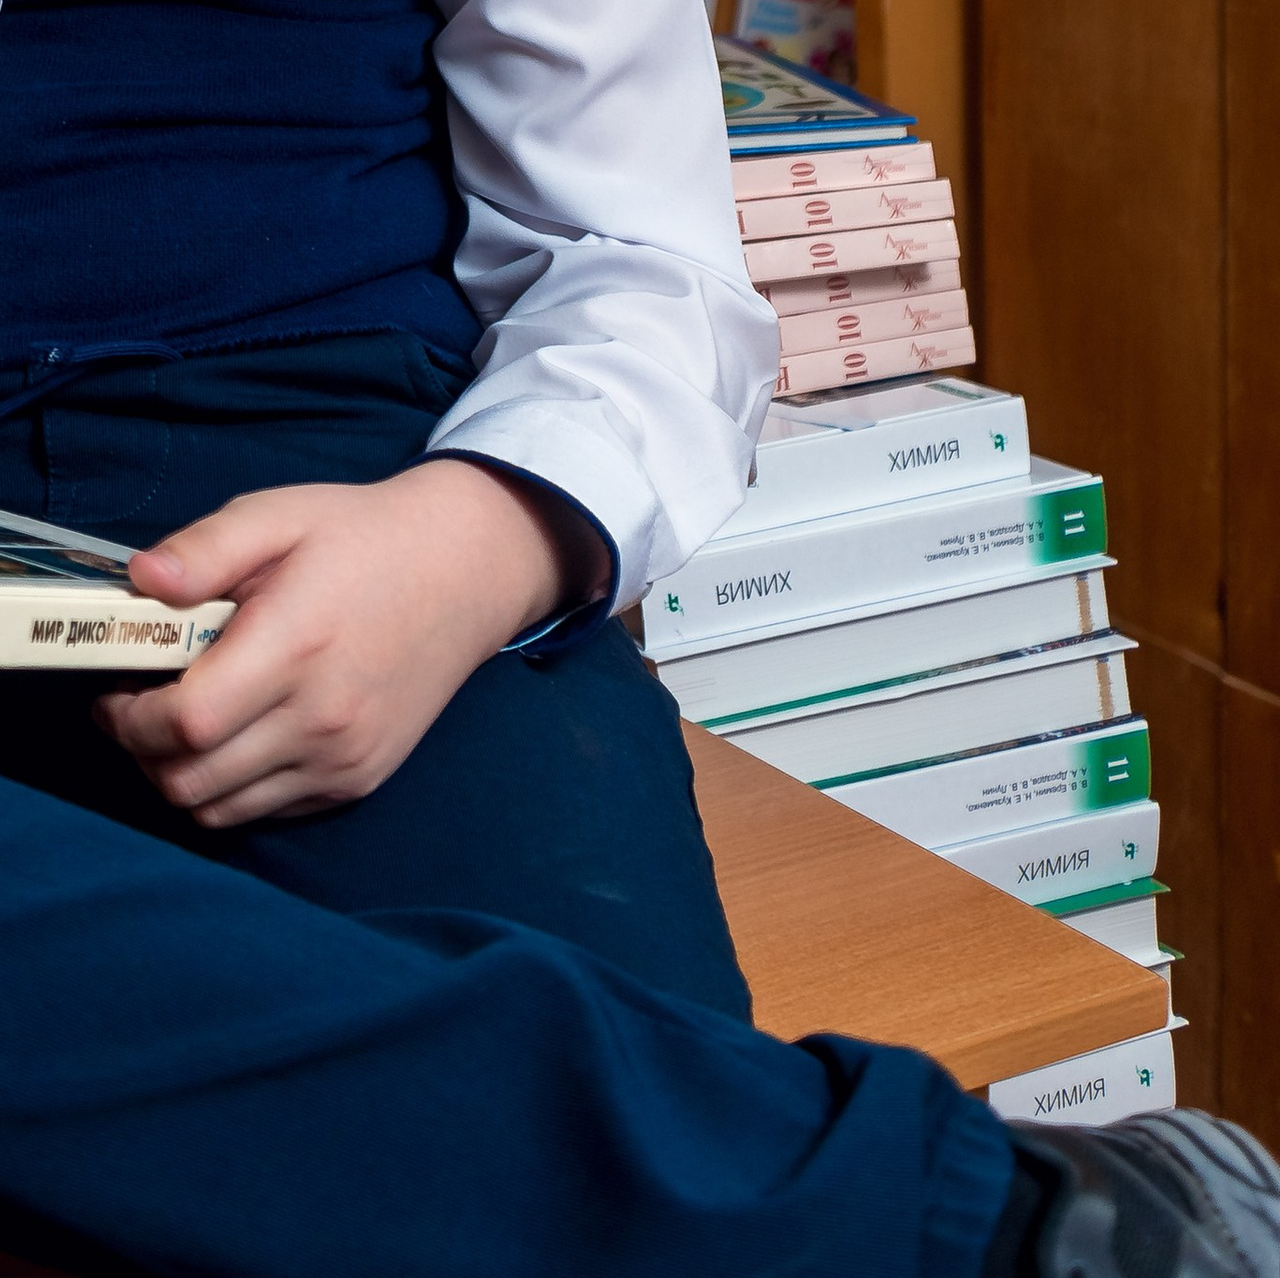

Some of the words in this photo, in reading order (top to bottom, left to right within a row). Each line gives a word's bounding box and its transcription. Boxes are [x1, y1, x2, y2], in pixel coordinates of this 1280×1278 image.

[888, 439, 960, 473] ХИМИЯ
[715, 570, 793, 606] ХИМИЯ
[31, 620, 64, 644] МИР
[65, 615, 117, 647] ДИКОЙ
[118, 621, 182, 648] ПРИРОДЫ
[1017, 849, 1090, 884] ХИМИЯ
[1034, 1078, 1106, 1116] ХИМИЯ
